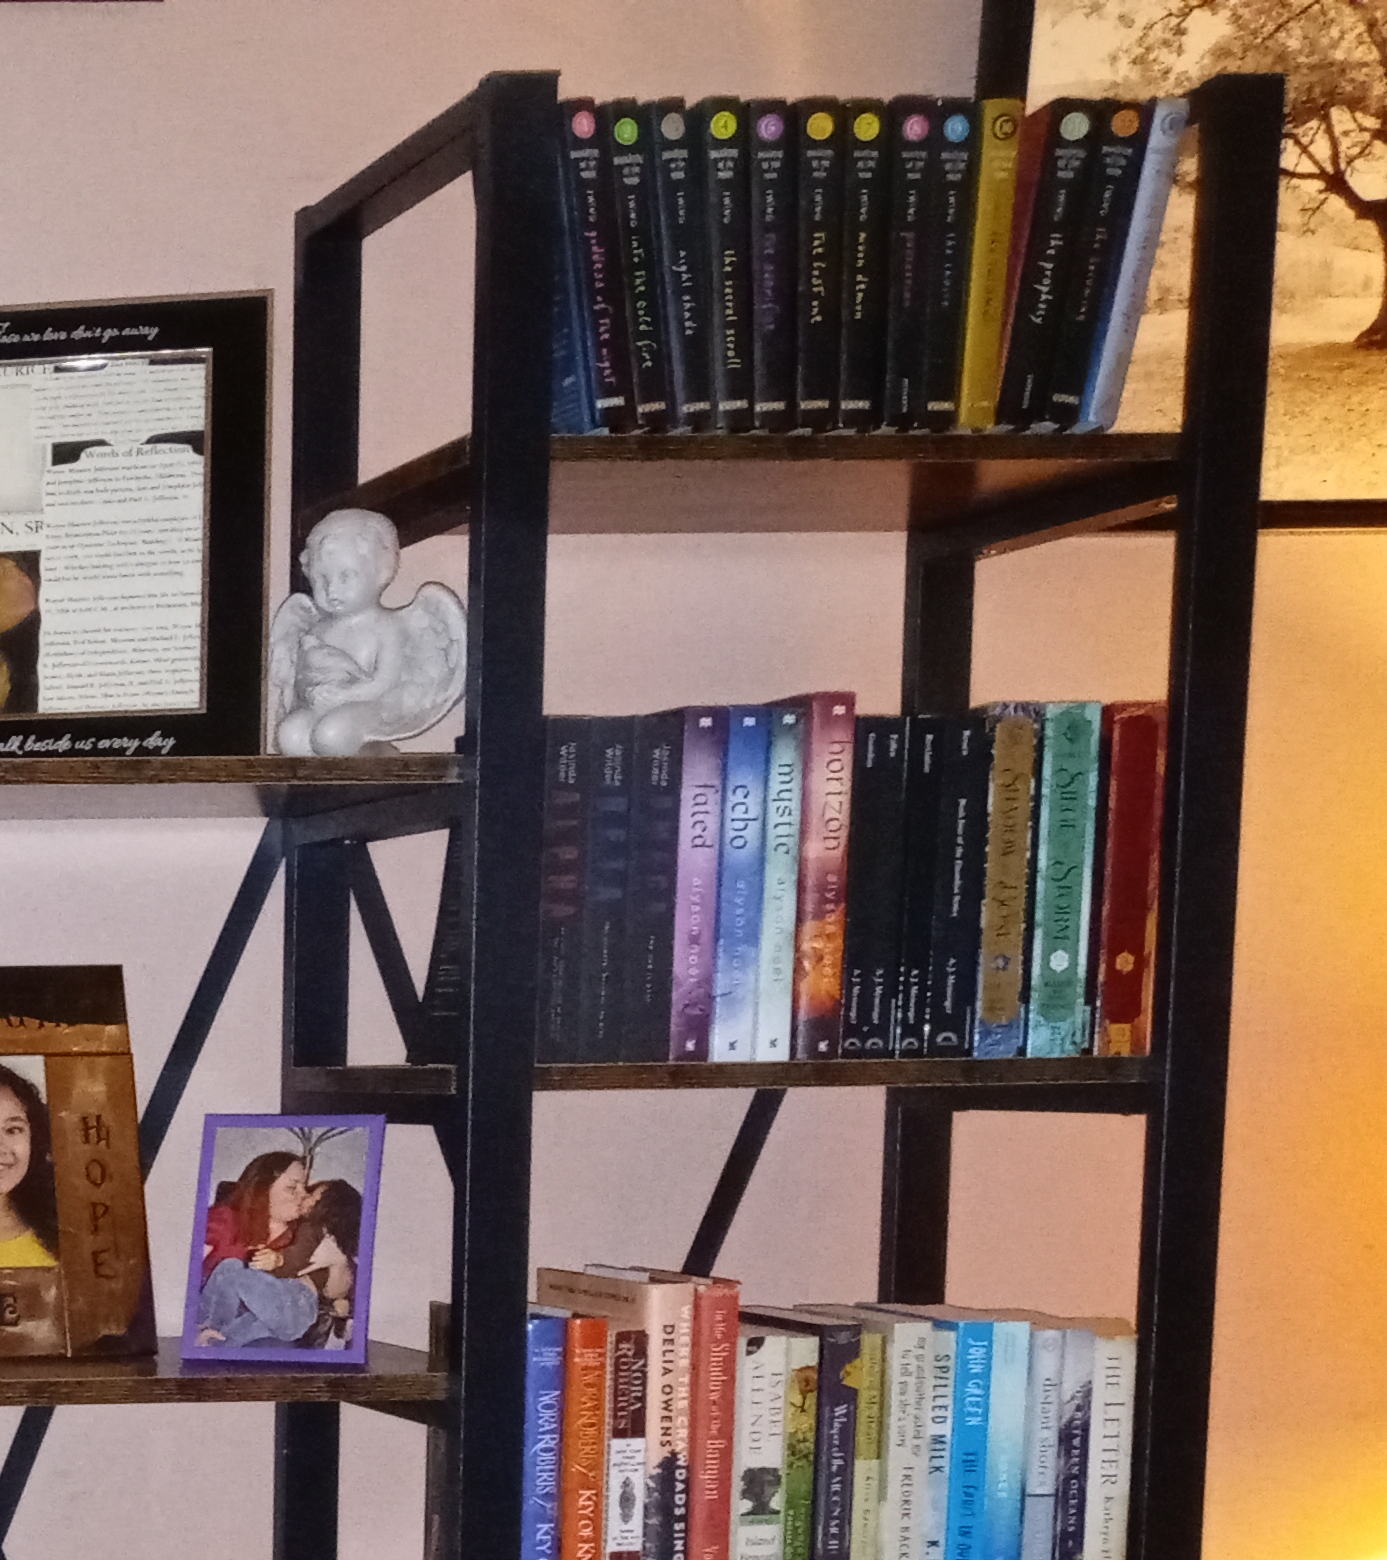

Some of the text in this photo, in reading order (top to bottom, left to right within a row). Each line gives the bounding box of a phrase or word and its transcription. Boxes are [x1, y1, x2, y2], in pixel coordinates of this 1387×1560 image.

[22, 332, 41, 342] we
[42, 327, 68, 341] love
[70, 325, 102, 341] don't
[102, 328, 120, 343] go
[121, 326, 159, 341] away
[631, 236, 656, 368] into the cold fire
[724, 250, 741, 368] the secret scroll
[83, 446, 190, 459] Words of Reflection
[24, 733, 73, 753] beside
[74, 737, 96, 750] us
[97, 736, 141, 756] every
[141, 730, 176, 754] day
[729, 784, 759, 850] echo
[772, 763, 795, 855] mystic
[822, 740, 853, 851] horizon
[79, 1113, 116, 1281] HOPE
[616, 1340, 633, 1430] ROBERTS
[659, 1323, 675, 1448] DELIA OWENS
[768, 1372, 783, 1438] ISABEL
[928, 1354, 951, 1475] SPILLED MILK
[964, 1338, 989, 1427] JOHN GREEN
[1100, 1356, 1126, 1486] THE LETTER
[577, 1520, 595, 1537] OF
[578, 1489, 597, 1517] KEY
[899, 1466, 915, 1520] FREDRIK
[535, 1523, 555, 1554] KEY
